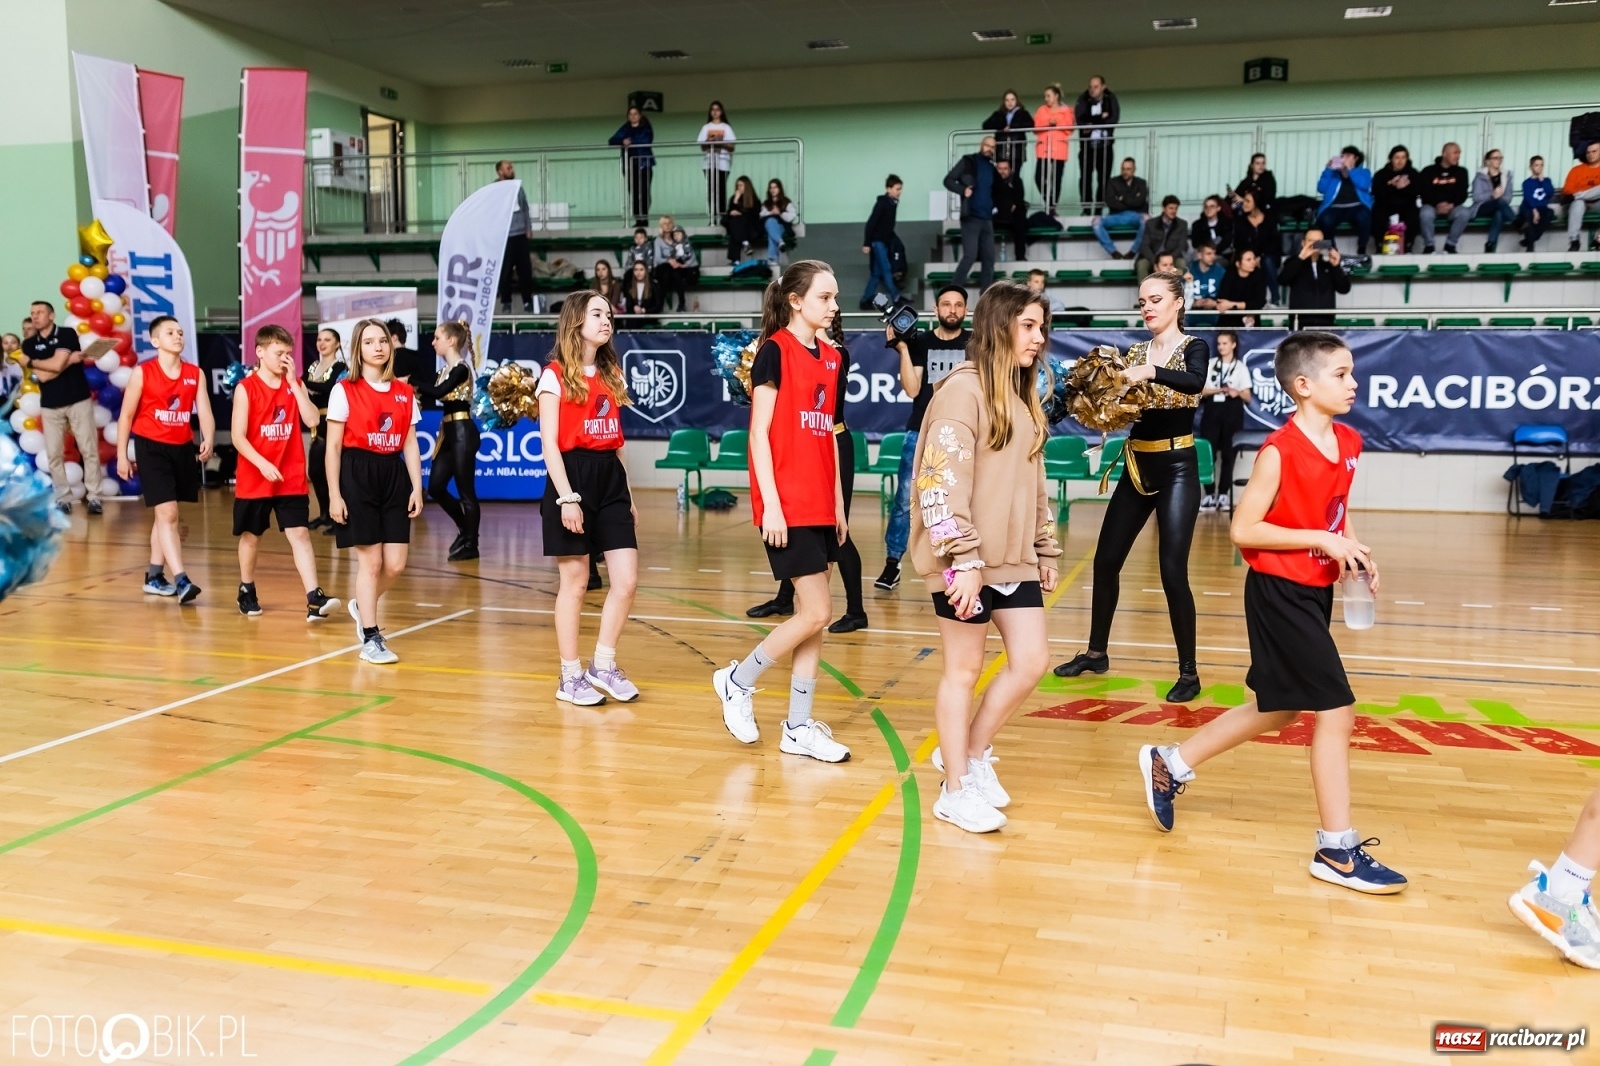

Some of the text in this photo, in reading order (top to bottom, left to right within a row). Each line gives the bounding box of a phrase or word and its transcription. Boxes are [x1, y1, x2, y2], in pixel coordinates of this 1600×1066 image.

[1249, 67, 1261, 80] B
[1271, 65, 1283, 78] B
[642, 98, 658, 110] A
[442, 254, 482, 327] SiR
[477, 259, 497, 326] RACIBÓRZ
[155, 409, 190, 423] PORTLAND
[484, 468, 494, 476] Jr.
[497, 467, 516, 477] NBA
